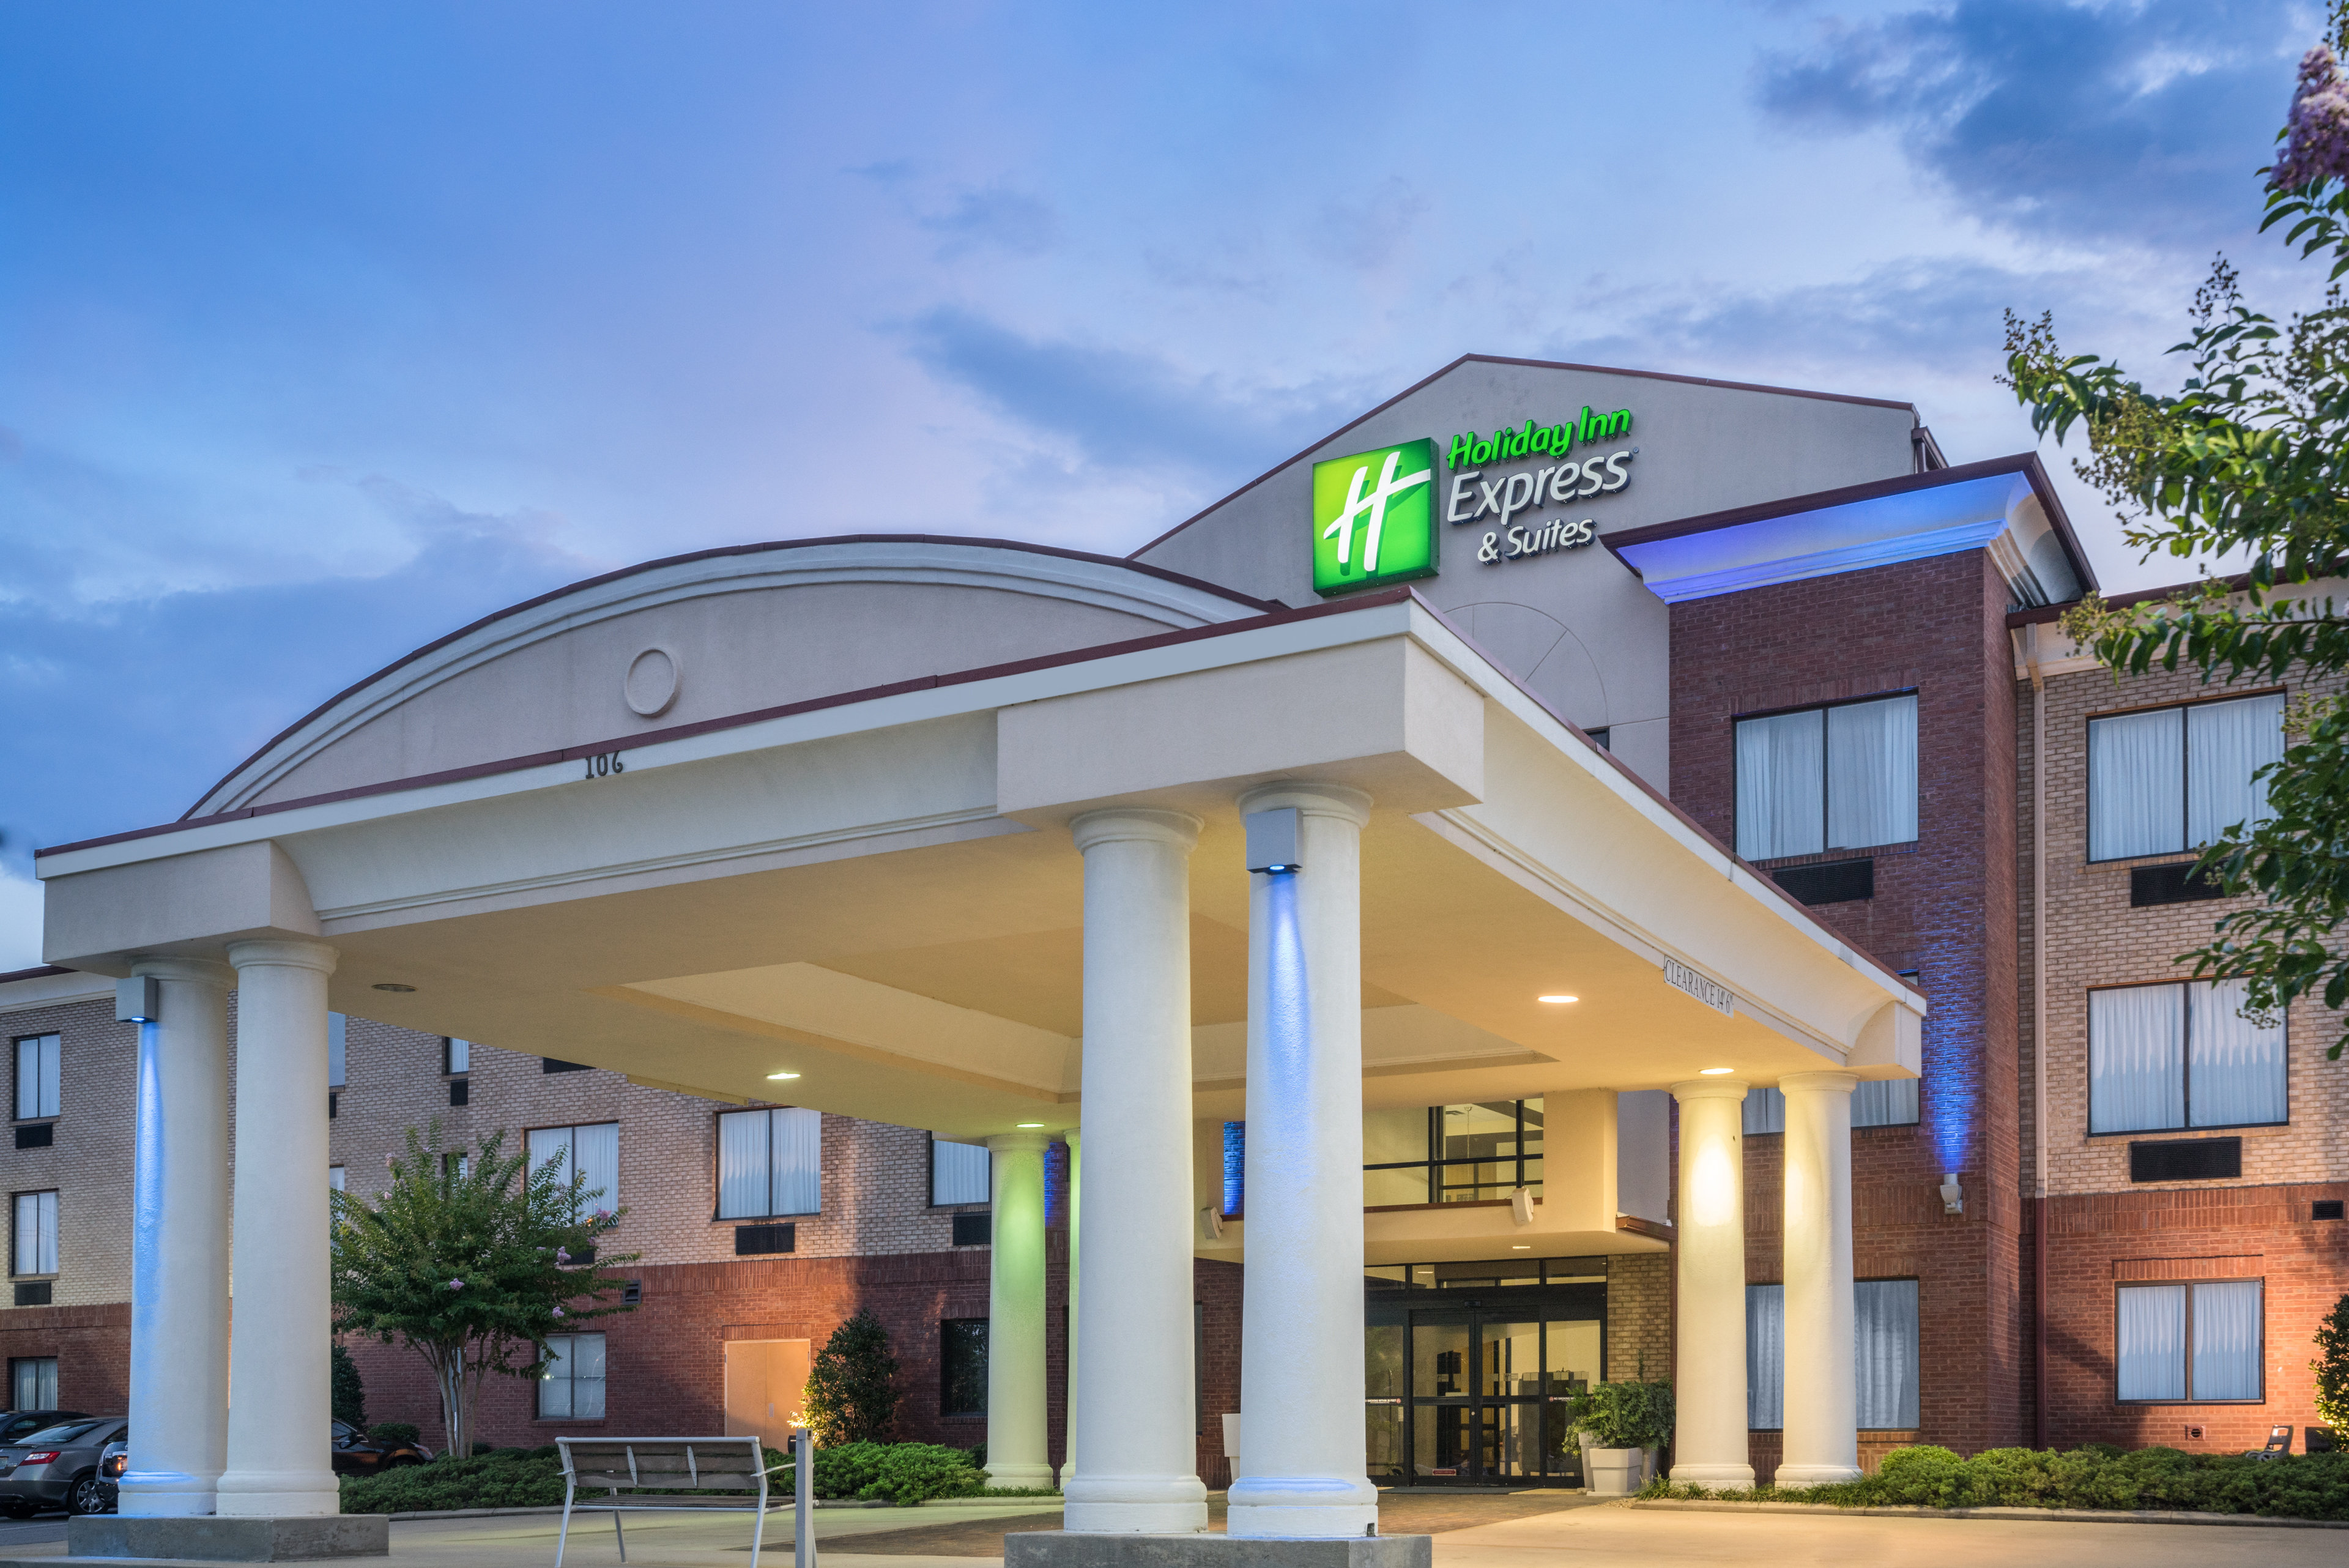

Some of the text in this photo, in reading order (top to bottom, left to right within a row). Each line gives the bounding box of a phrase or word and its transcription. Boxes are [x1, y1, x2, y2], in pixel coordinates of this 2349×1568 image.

[1447, 406, 1631, 470] Holiday Inn
[1447, 450, 1633, 526] Express
[1477, 518, 1596, 563] & Suites
[585, 750, 623, 779] 106
[1665, 959, 1715, 1005] CLEARANCE
